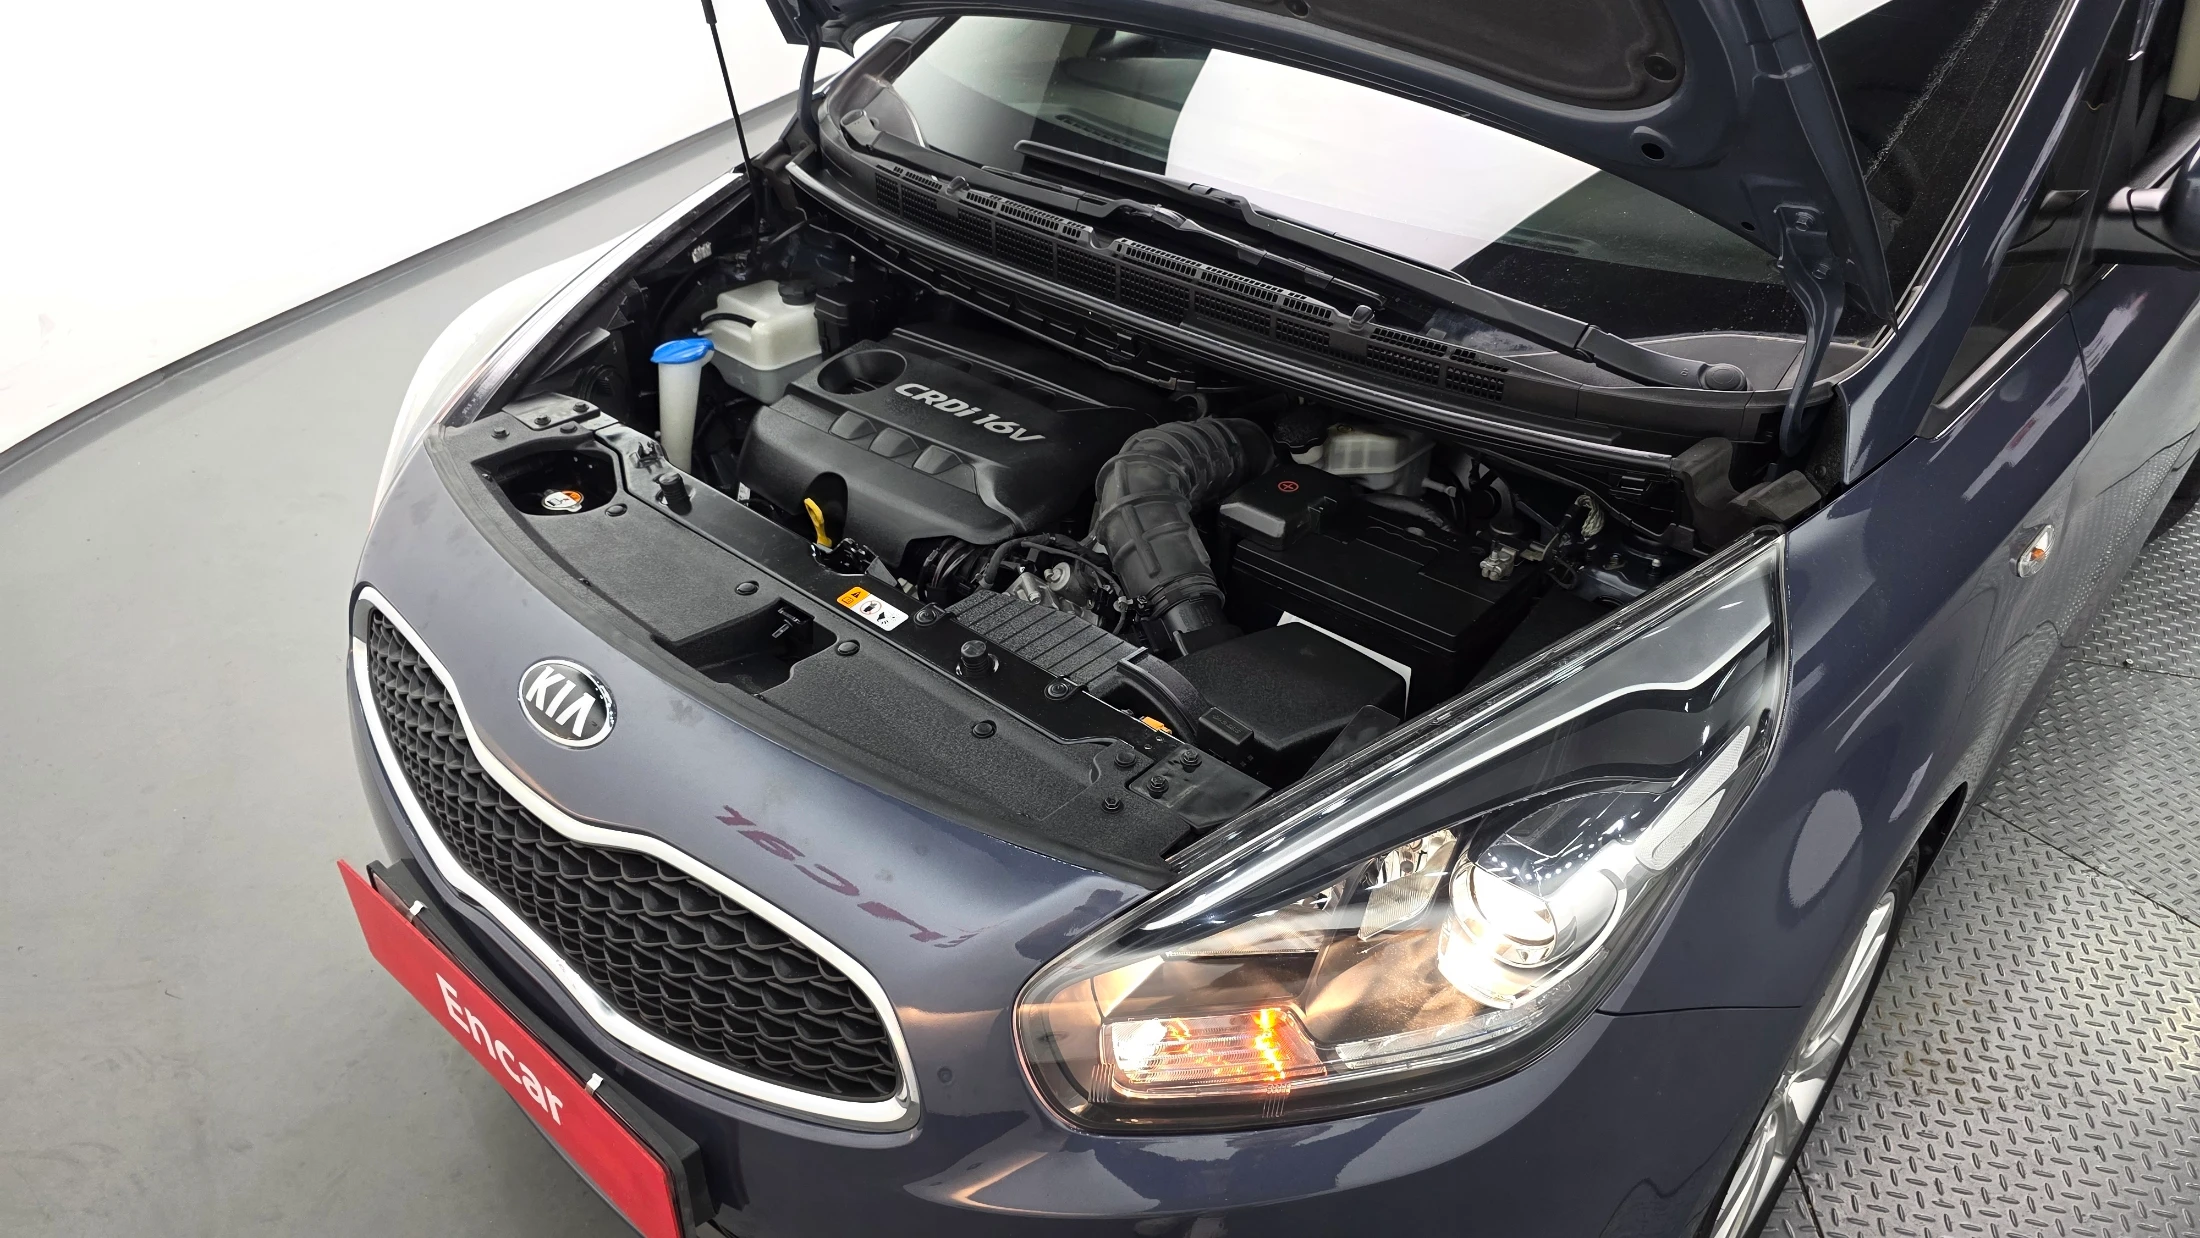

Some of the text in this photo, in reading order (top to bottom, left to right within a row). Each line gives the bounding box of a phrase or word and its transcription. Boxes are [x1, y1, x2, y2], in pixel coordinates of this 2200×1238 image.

[894, 383, 1046, 442] CRDi 16V
[525, 665, 596, 738] KIA
[435, 972, 564, 1126] Encar
